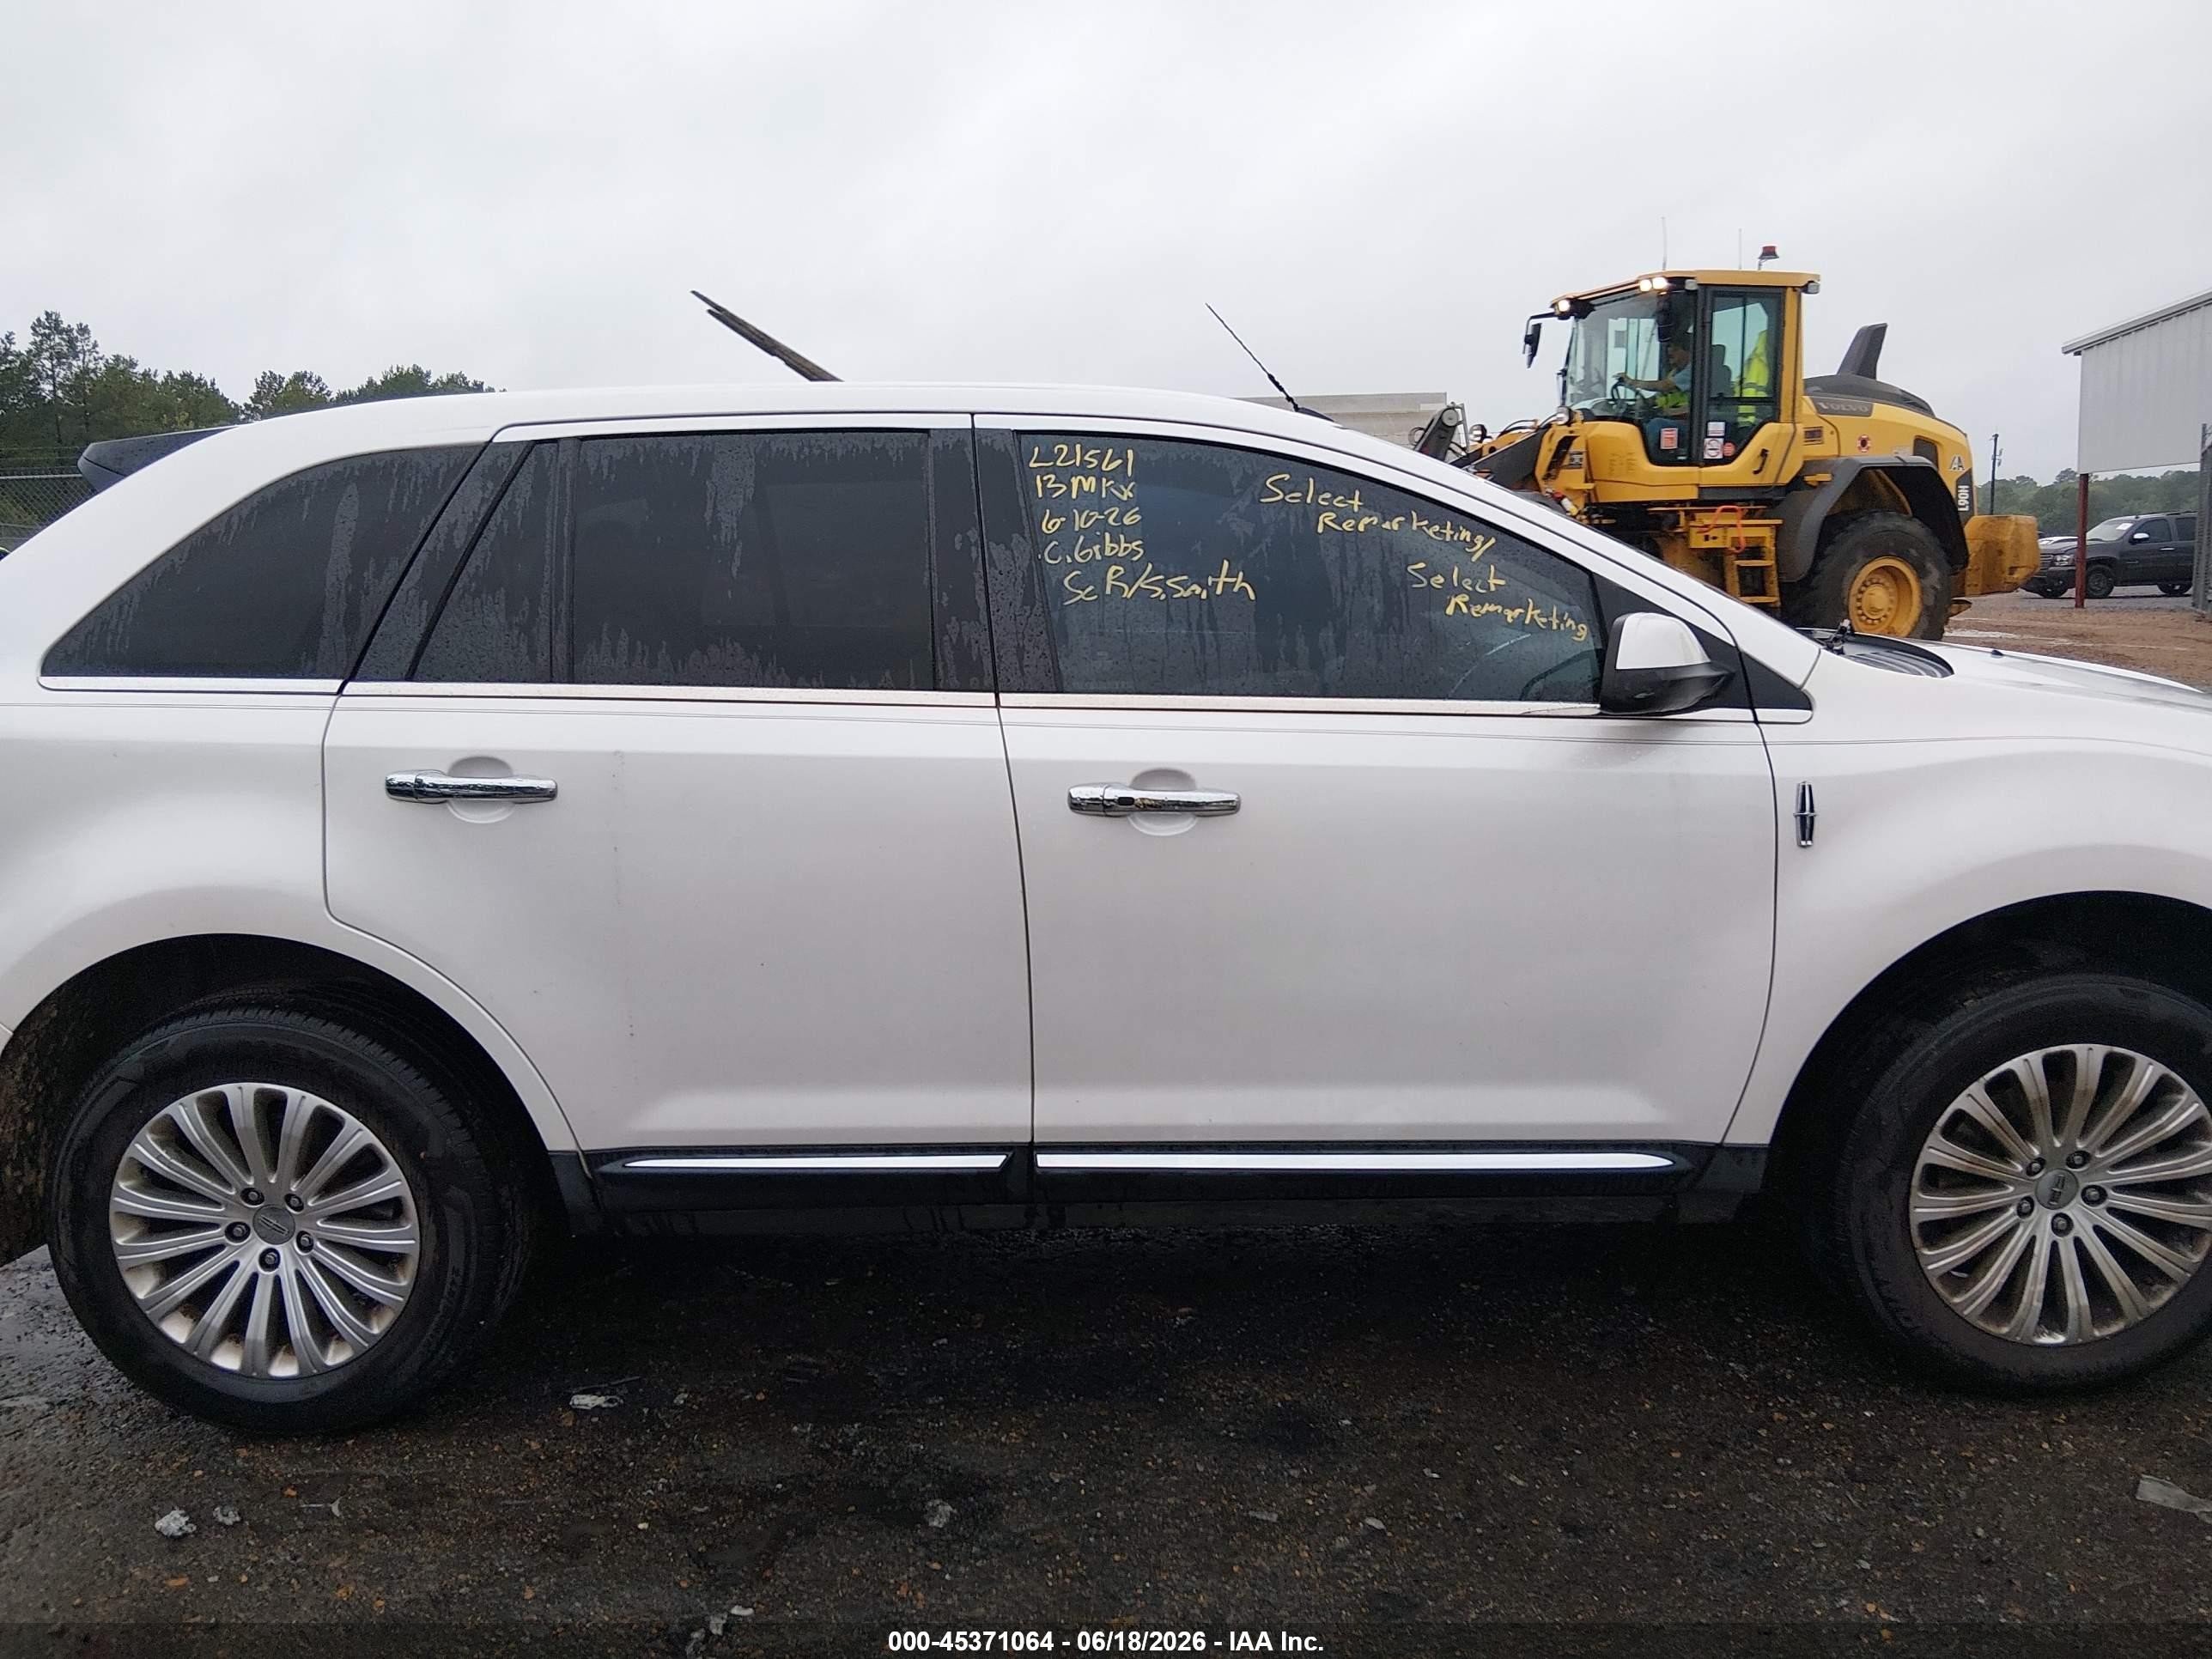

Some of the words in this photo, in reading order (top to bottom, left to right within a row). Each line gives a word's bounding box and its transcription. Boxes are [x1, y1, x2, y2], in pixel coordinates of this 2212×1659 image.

[1029, 443, 1134, 477] L21561
[1036, 474, 1067, 498] 13
[1259, 473, 1364, 513] Select
[1957, 484, 1970, 512] L90H
[1407, 562, 1506, 593] Select
[1445, 592, 1588, 642] Remarketing
